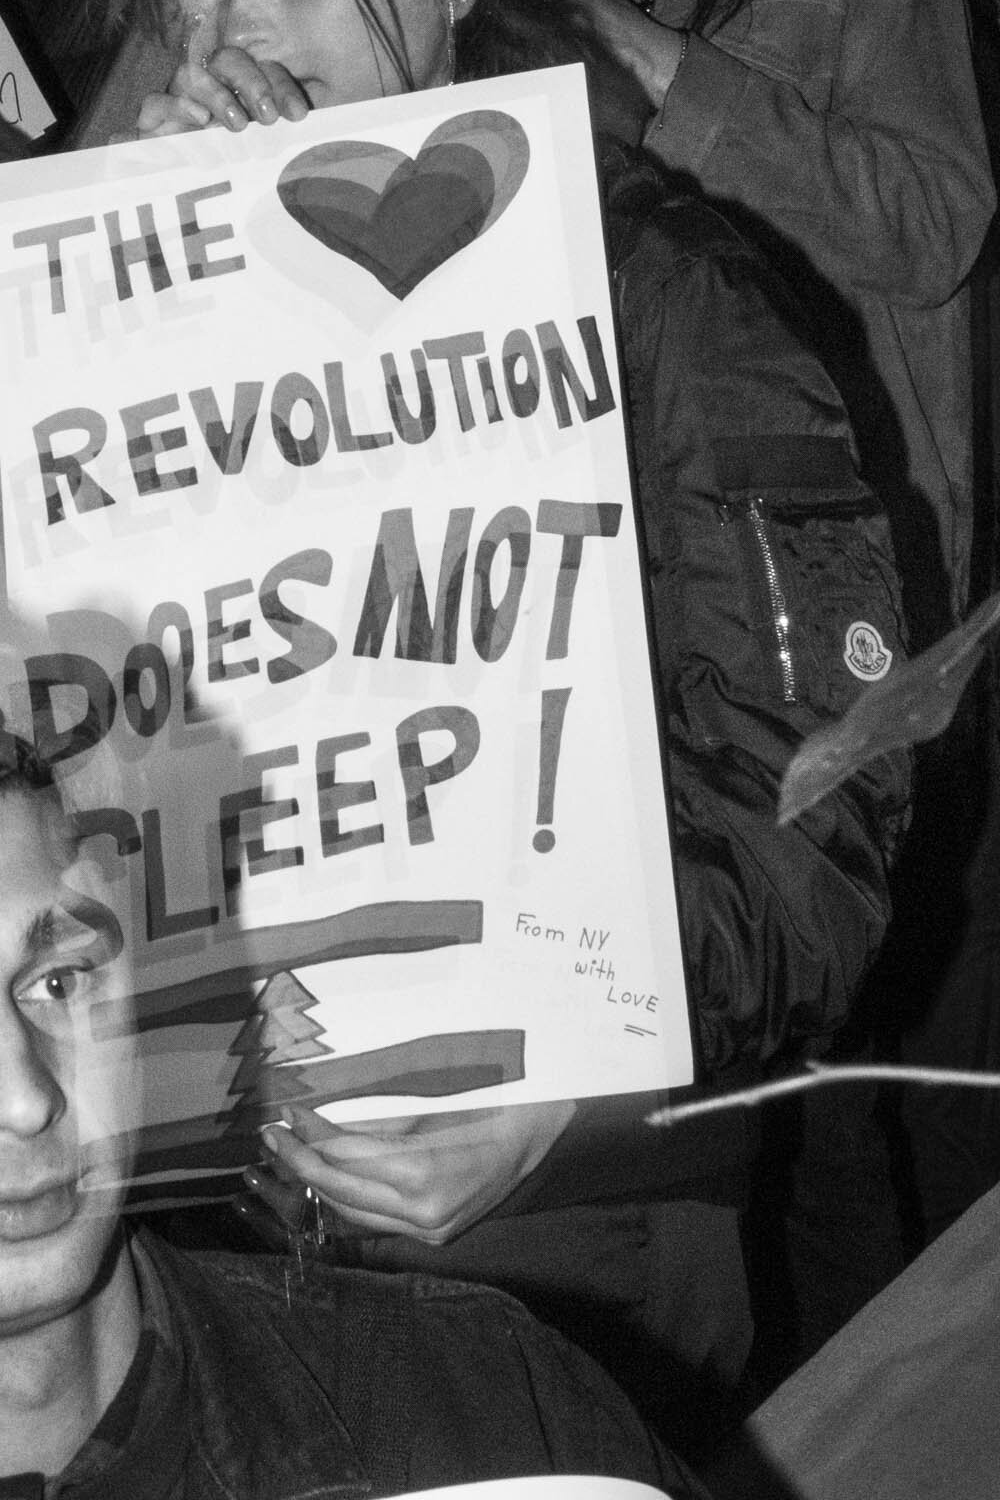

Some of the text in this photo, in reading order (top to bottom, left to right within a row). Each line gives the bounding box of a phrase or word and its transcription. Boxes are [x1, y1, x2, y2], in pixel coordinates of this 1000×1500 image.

[13, 180, 246, 315] THE
[25, 498, 623, 768] DOES NOT
[516, 912, 611, 951] From NY
[574, 958, 616, 981] with
[606, 985, 660, 1013] LOVE
